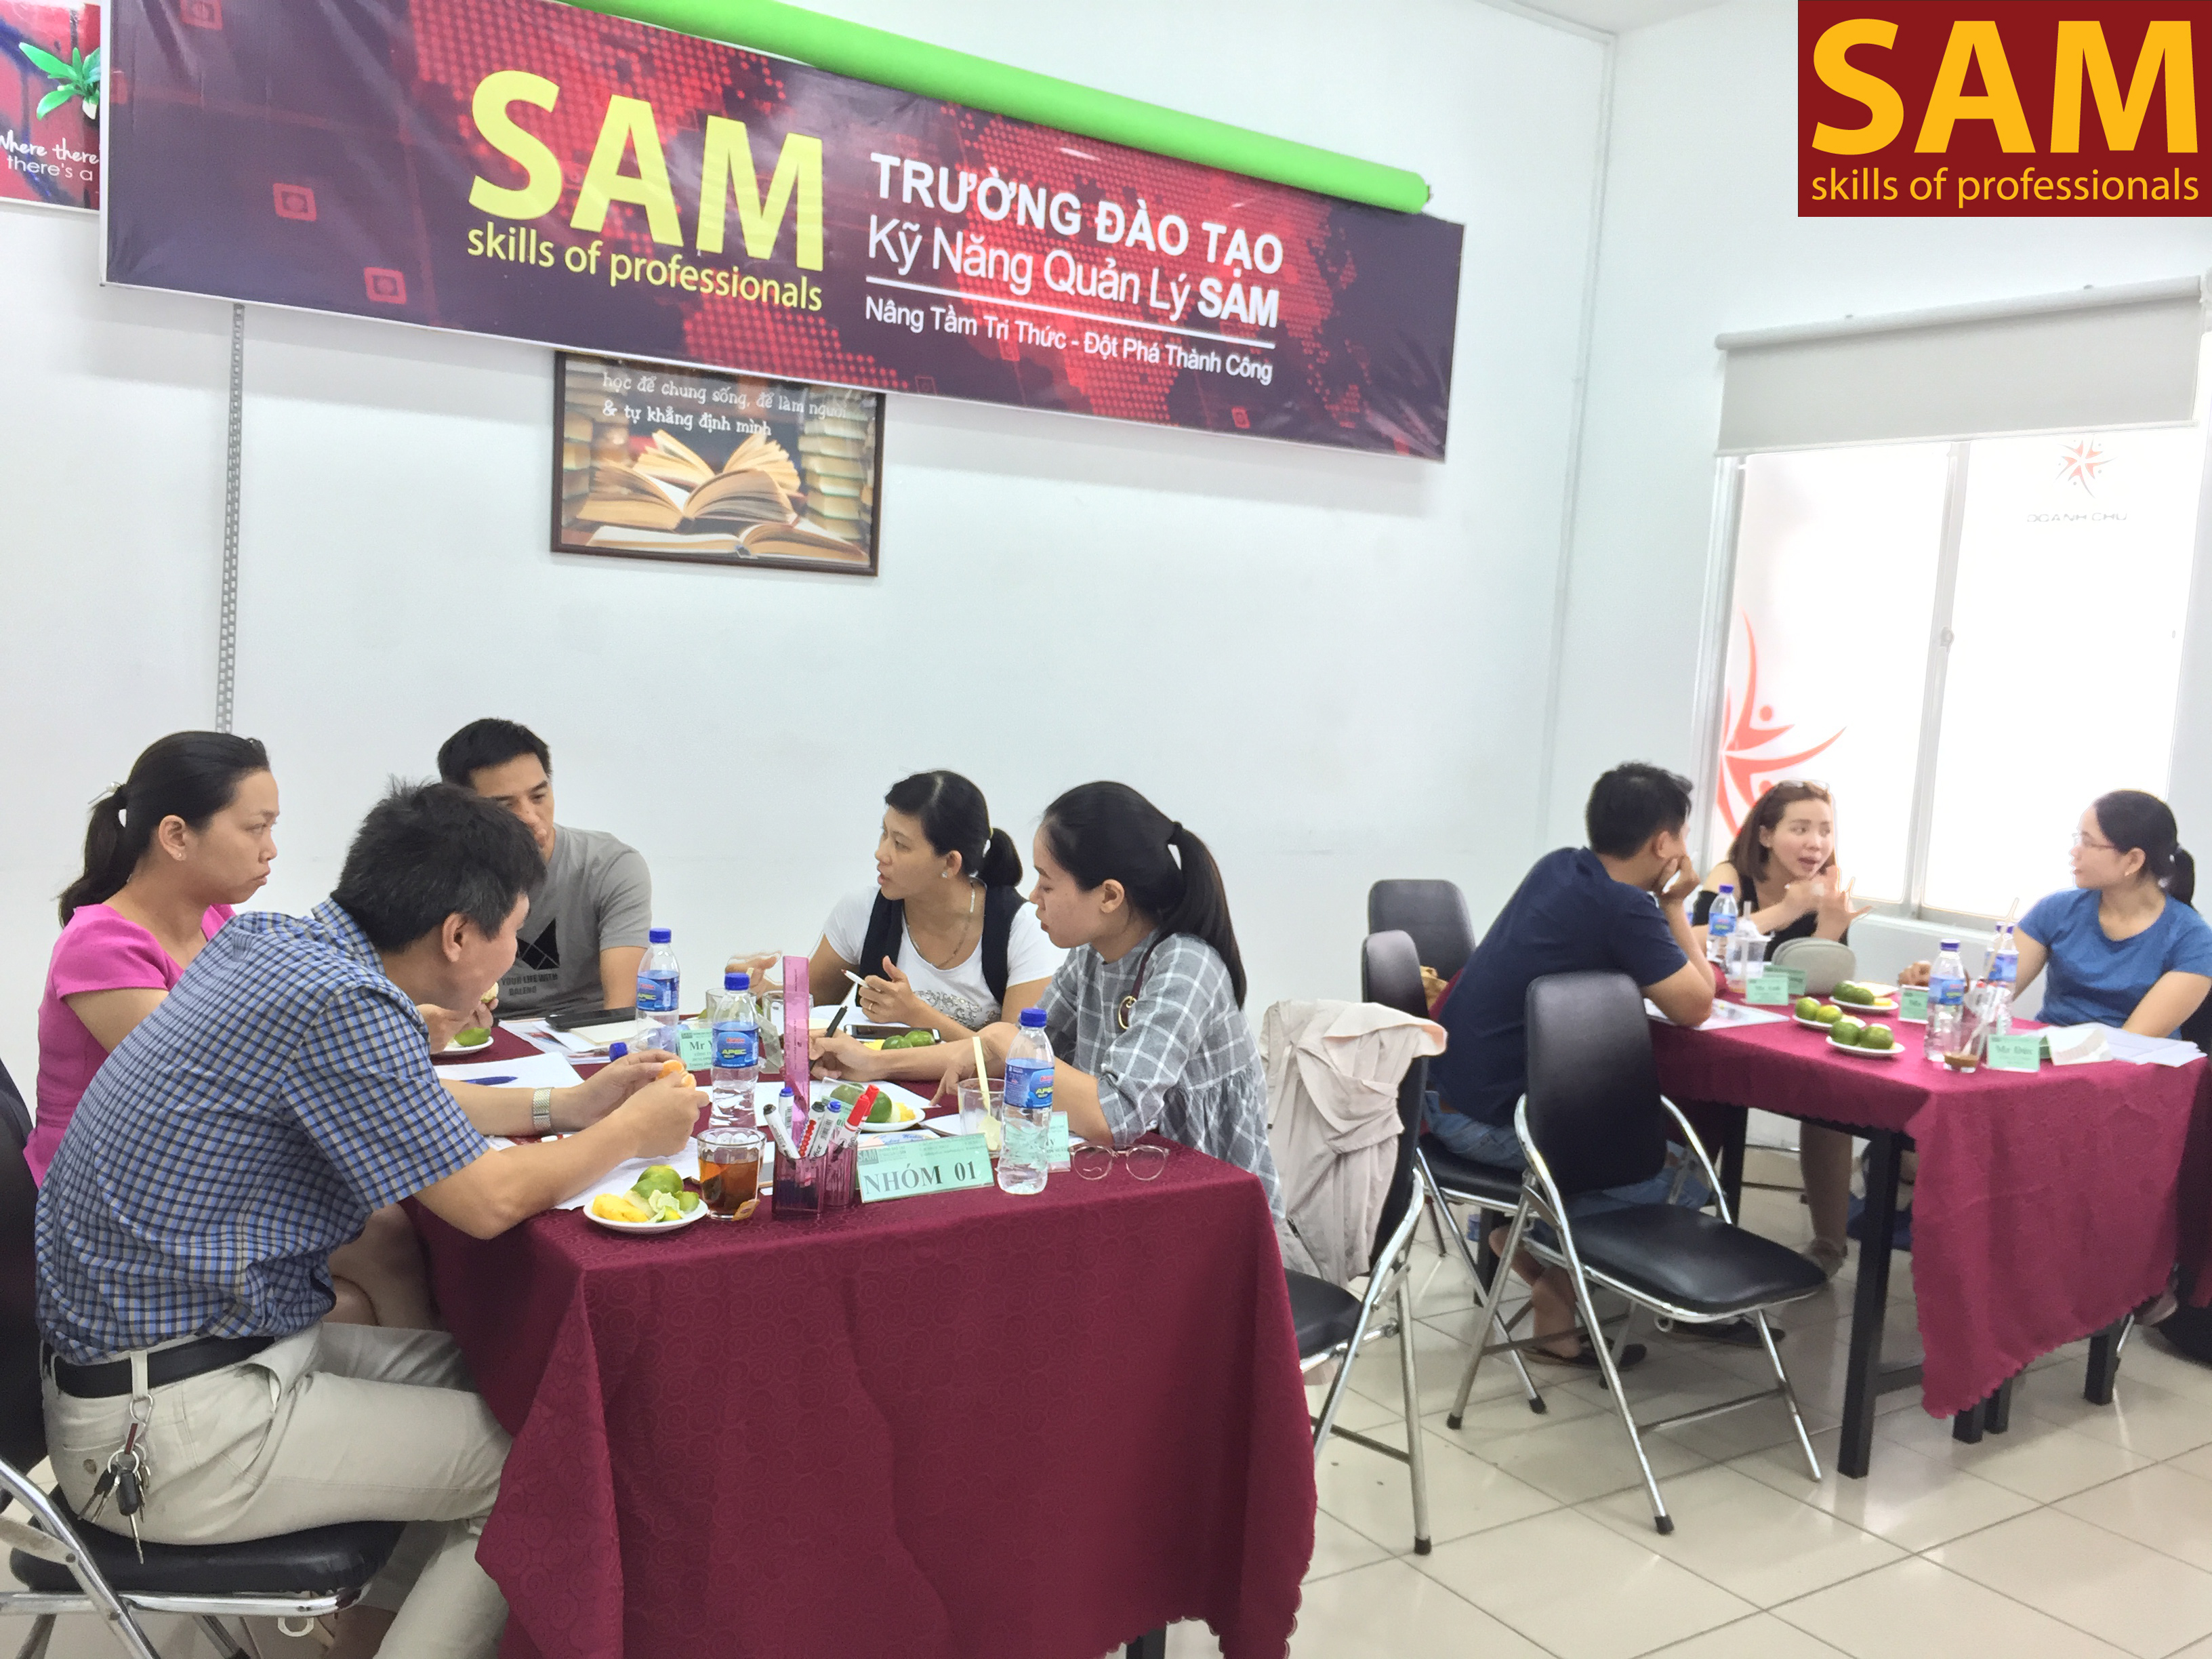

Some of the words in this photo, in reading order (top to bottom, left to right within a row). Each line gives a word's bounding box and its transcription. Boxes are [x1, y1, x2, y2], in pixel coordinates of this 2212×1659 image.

[0, 129, 47, 157] Where
[7, 155, 73, 178] there's
[79, 169, 93, 181] a
[469, 70, 823, 271] SAM
[870, 152, 1081, 235] TRƯỜNG
[1094, 199, 1189, 255] ĐÀO
[1202, 221, 1283, 277] TẠO
[468, 222, 554, 267] skills
[565, 241, 602, 274] of
[610, 253, 822, 311] professionals
[869, 215, 922, 275] Kỹ
[933, 227, 1033, 295] Năng
[1044, 249, 1140, 304] Quản
[1150, 268, 1191, 321] Lý
[1197, 277, 1279, 327] SAM
[866, 295, 924, 333] Nâng
[930, 304, 977, 336] Tầm
[1015, 320, 1067, 349] Thức
[1084, 331, 1118, 360] Đột
[1123, 337, 1160, 363] Phá
[1165, 344, 1221, 373] Thành
[1226, 354, 1273, 386] Công
[602, 372, 632, 392] học
[661, 381, 707, 405] chung
[779, 395, 804, 413] làm
[602, 399, 618, 416] &
[699, 411, 731, 434] định
[690, 1041, 705, 1051] Mr
[863, 1163, 943, 1195] NHÓM
[954, 1161, 977, 1181] 01
